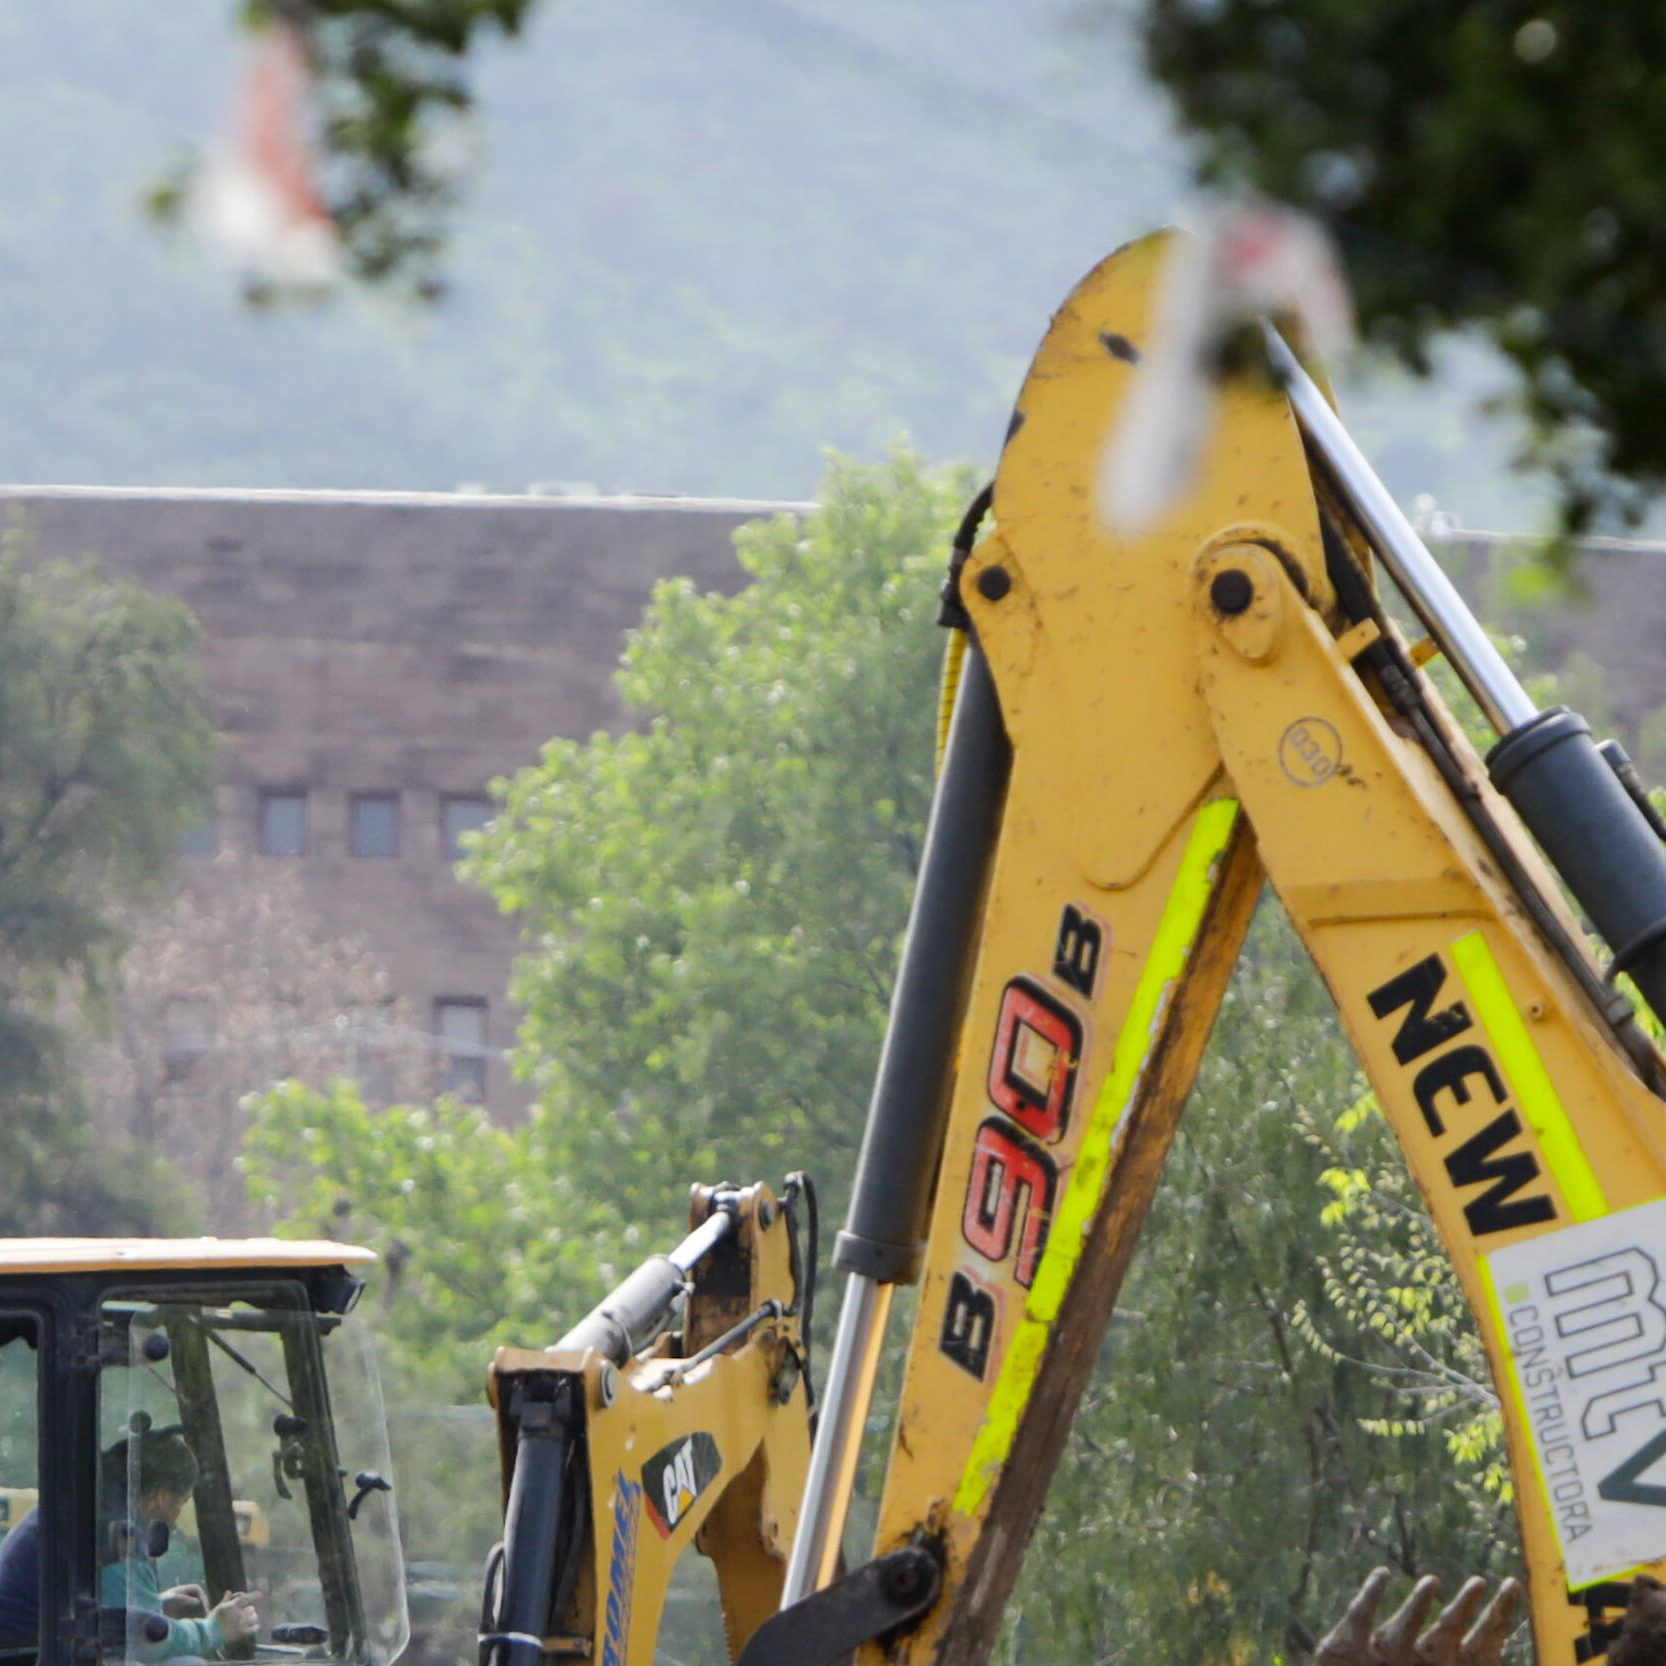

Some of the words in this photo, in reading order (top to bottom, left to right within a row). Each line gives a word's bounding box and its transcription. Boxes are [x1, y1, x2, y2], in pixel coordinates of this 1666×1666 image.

[1366, 952, 1559, 1237] NEW
[662, 1437, 698, 1525] CAT
[1507, 1303, 1593, 1544] CONSTRUCTORA
